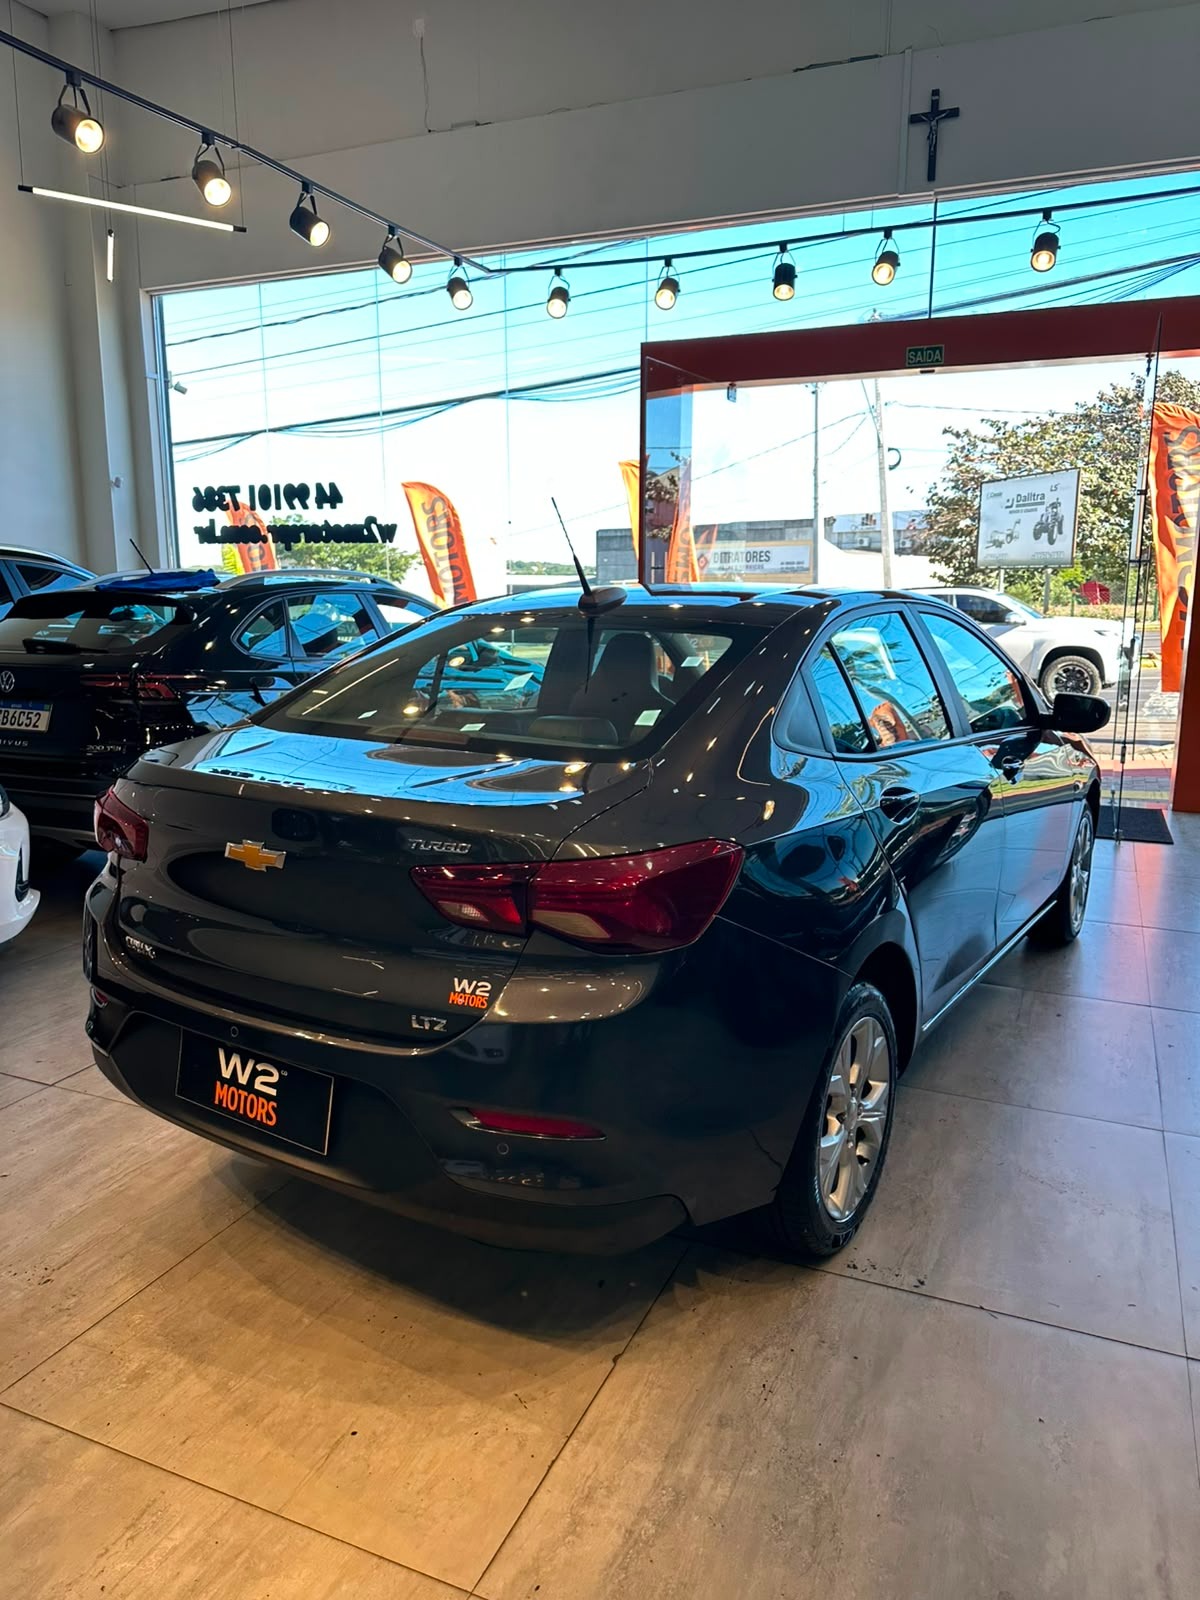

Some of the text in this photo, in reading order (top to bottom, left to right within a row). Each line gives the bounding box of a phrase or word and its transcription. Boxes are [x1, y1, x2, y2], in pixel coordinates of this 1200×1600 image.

[908, 347, 942, 364] SAÍDA
[1015, 492, 1045, 503] Dalltra
[0, 709, 41, 729] B6C52
[408, 838, 472, 855] TURBO
[453, 977, 492, 997] W2
[449, 992, 489, 1009] MOTORS
[411, 1014, 448, 1032] LTZ
[218, 1047, 279, 1096] W2
[214, 1080, 278, 1127] MOTORS
